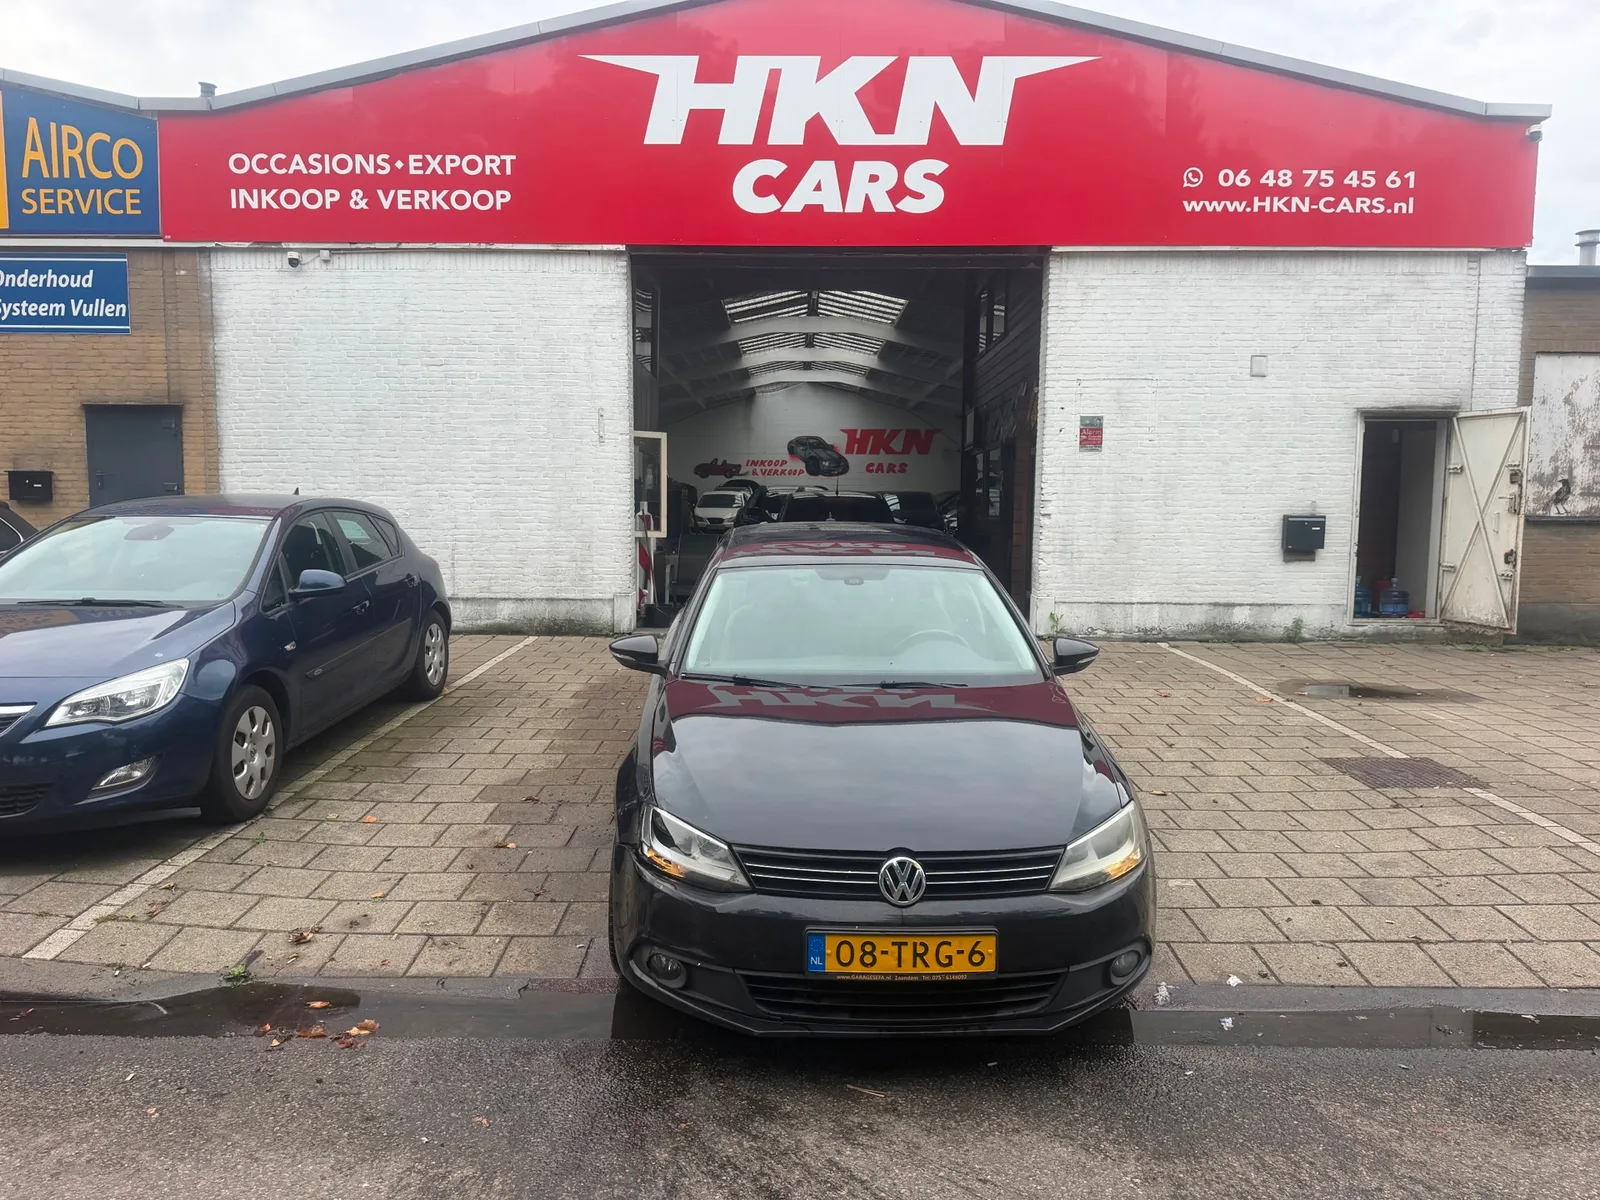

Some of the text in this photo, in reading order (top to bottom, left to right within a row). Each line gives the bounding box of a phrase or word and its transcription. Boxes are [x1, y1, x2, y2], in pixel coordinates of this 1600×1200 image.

[577, 55, 1102, 145] HKN
[22, 117, 143, 179] AIRCO
[228, 153, 516, 176] OCCASIONS EXPORT
[732, 158, 949, 214] CARS
[1218, 169, 1416, 189] 06 48 75 45 61
[21, 188, 141, 215] SERVICE
[230, 188, 511, 210] INKOOP & VERKOOP
[1183, 196, 1415, 214] www.HKN-CARS.nl
[0, 299, 127, 320] ysteem Vullen
[840, 428, 943, 455] HKN
[746, 459, 788, 468] INKOOP
[865, 462, 908, 474] CARS
[810, 957, 823, 965] NL
[835, 940, 986, 968] 08-TRG-6
